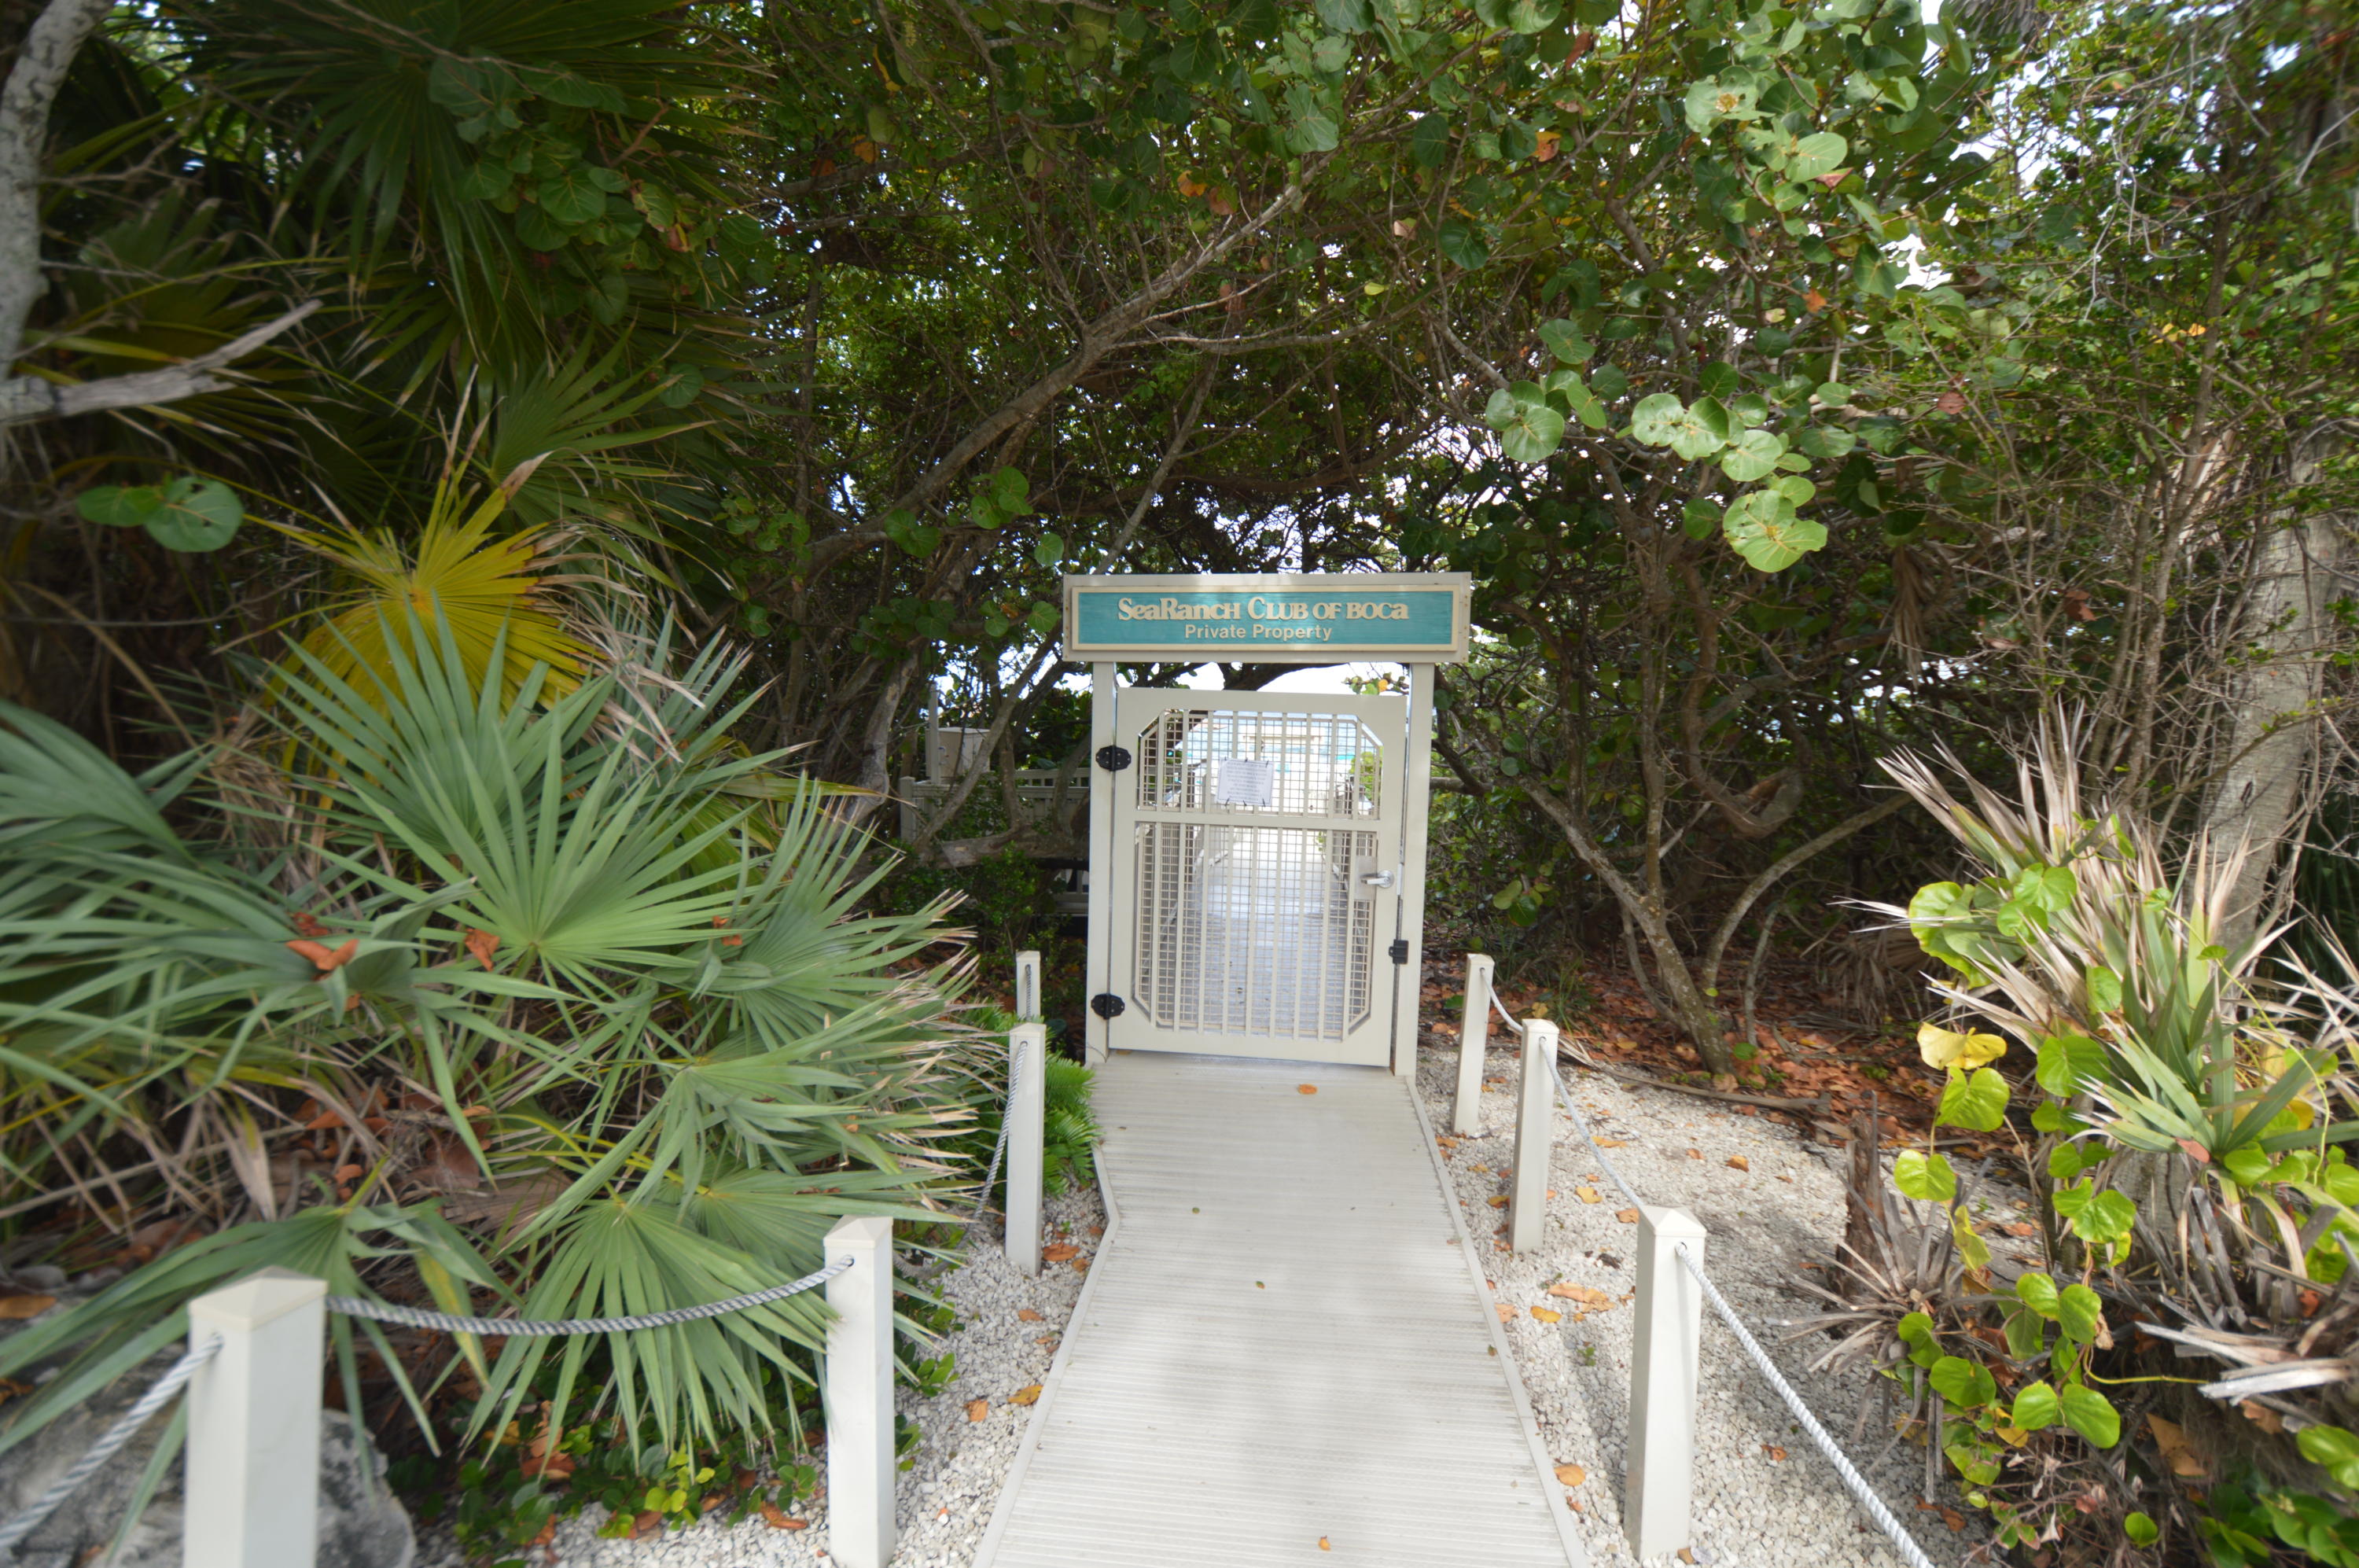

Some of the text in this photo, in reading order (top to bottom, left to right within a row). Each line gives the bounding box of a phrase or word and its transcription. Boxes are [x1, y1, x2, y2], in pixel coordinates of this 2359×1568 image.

[1247, 596, 1309, 620] CLUB
[1312, 602, 1342, 620] OF
[1185, 624, 1333, 642] Private Property
